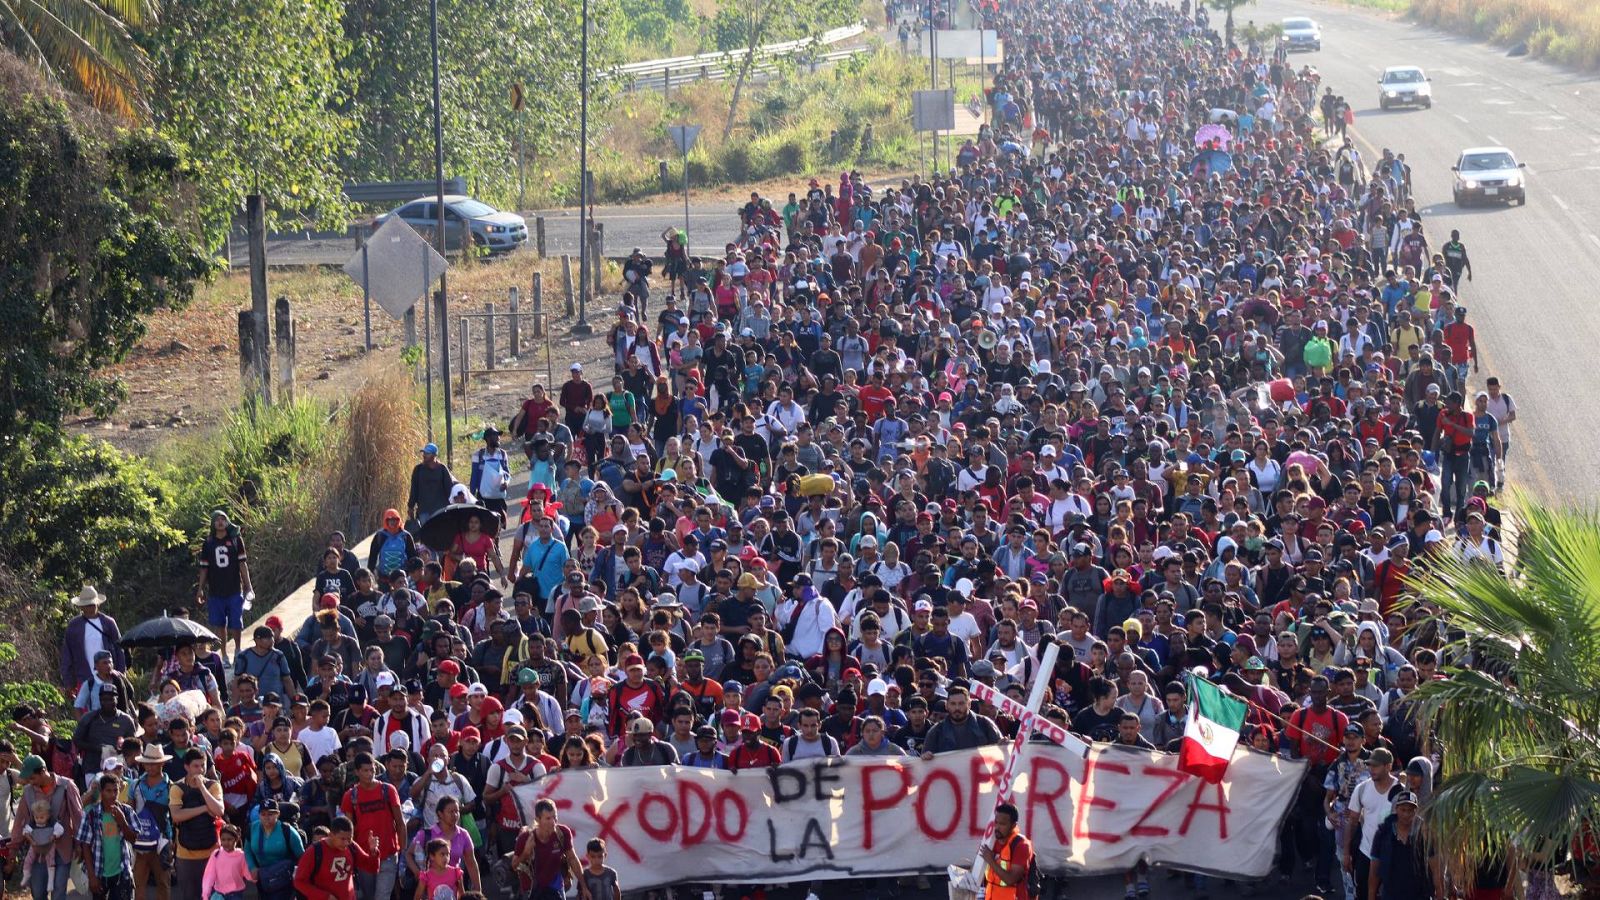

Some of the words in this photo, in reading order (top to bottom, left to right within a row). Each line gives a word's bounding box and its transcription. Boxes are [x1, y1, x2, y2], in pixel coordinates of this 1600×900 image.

[215, 545, 229, 568] 6
[768, 760, 845, 804] DE
[861, 756, 1231, 851] POBREZA
[502, 816, 522, 829] NIK
[767, 817, 836, 864] LA
